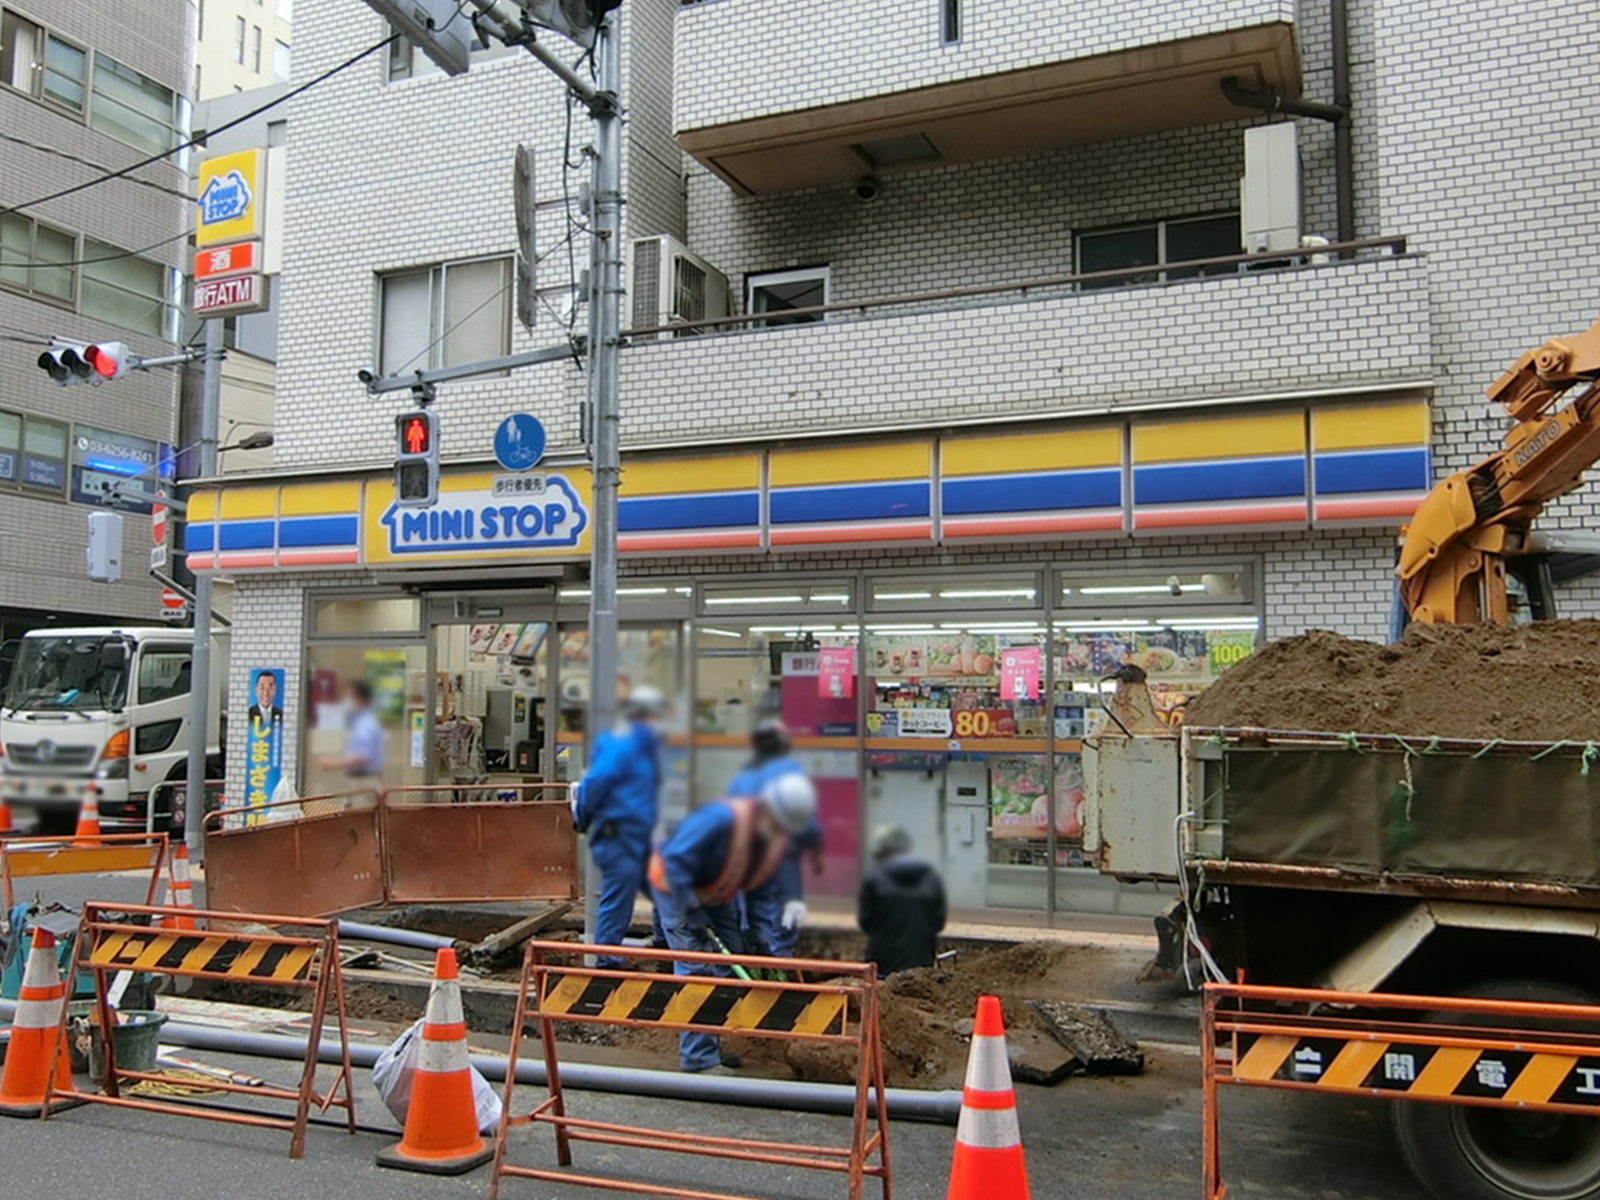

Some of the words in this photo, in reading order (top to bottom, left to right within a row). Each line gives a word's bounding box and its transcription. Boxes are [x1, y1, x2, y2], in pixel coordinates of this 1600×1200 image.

[210, 186, 238, 202] MINI
[208, 200, 239, 219] STOP
[210, 249, 231, 272] 酒
[195, 279, 250, 309] 銀行ATM
[1515, 421, 1561, 467] KATO
[496, 478, 541, 492] 歩行者優先
[402, 508, 474, 542] MINI
[480, 503, 566, 538] STOP
[955, 711, 990, 736] 80
